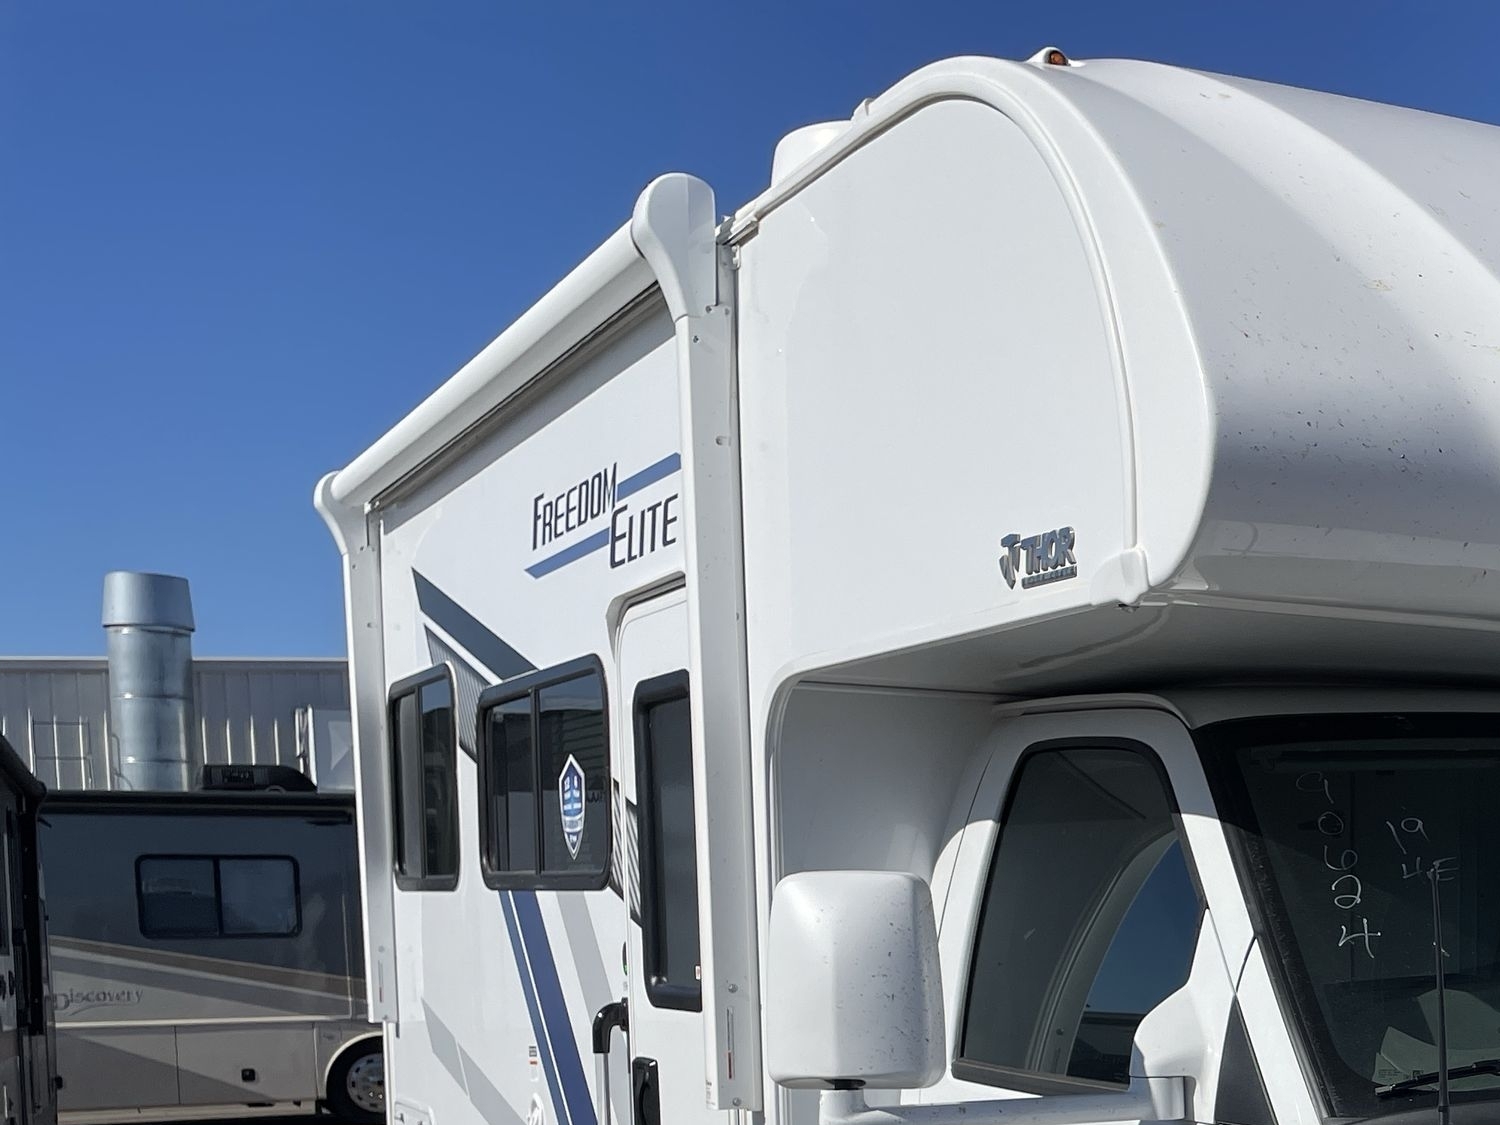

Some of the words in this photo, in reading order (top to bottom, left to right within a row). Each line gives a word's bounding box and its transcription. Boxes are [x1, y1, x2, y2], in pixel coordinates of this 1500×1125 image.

[532, 461, 618, 552] FREEDOM
[609, 492, 679, 570] ELITE
[1020, 526, 1077, 576] THOR
